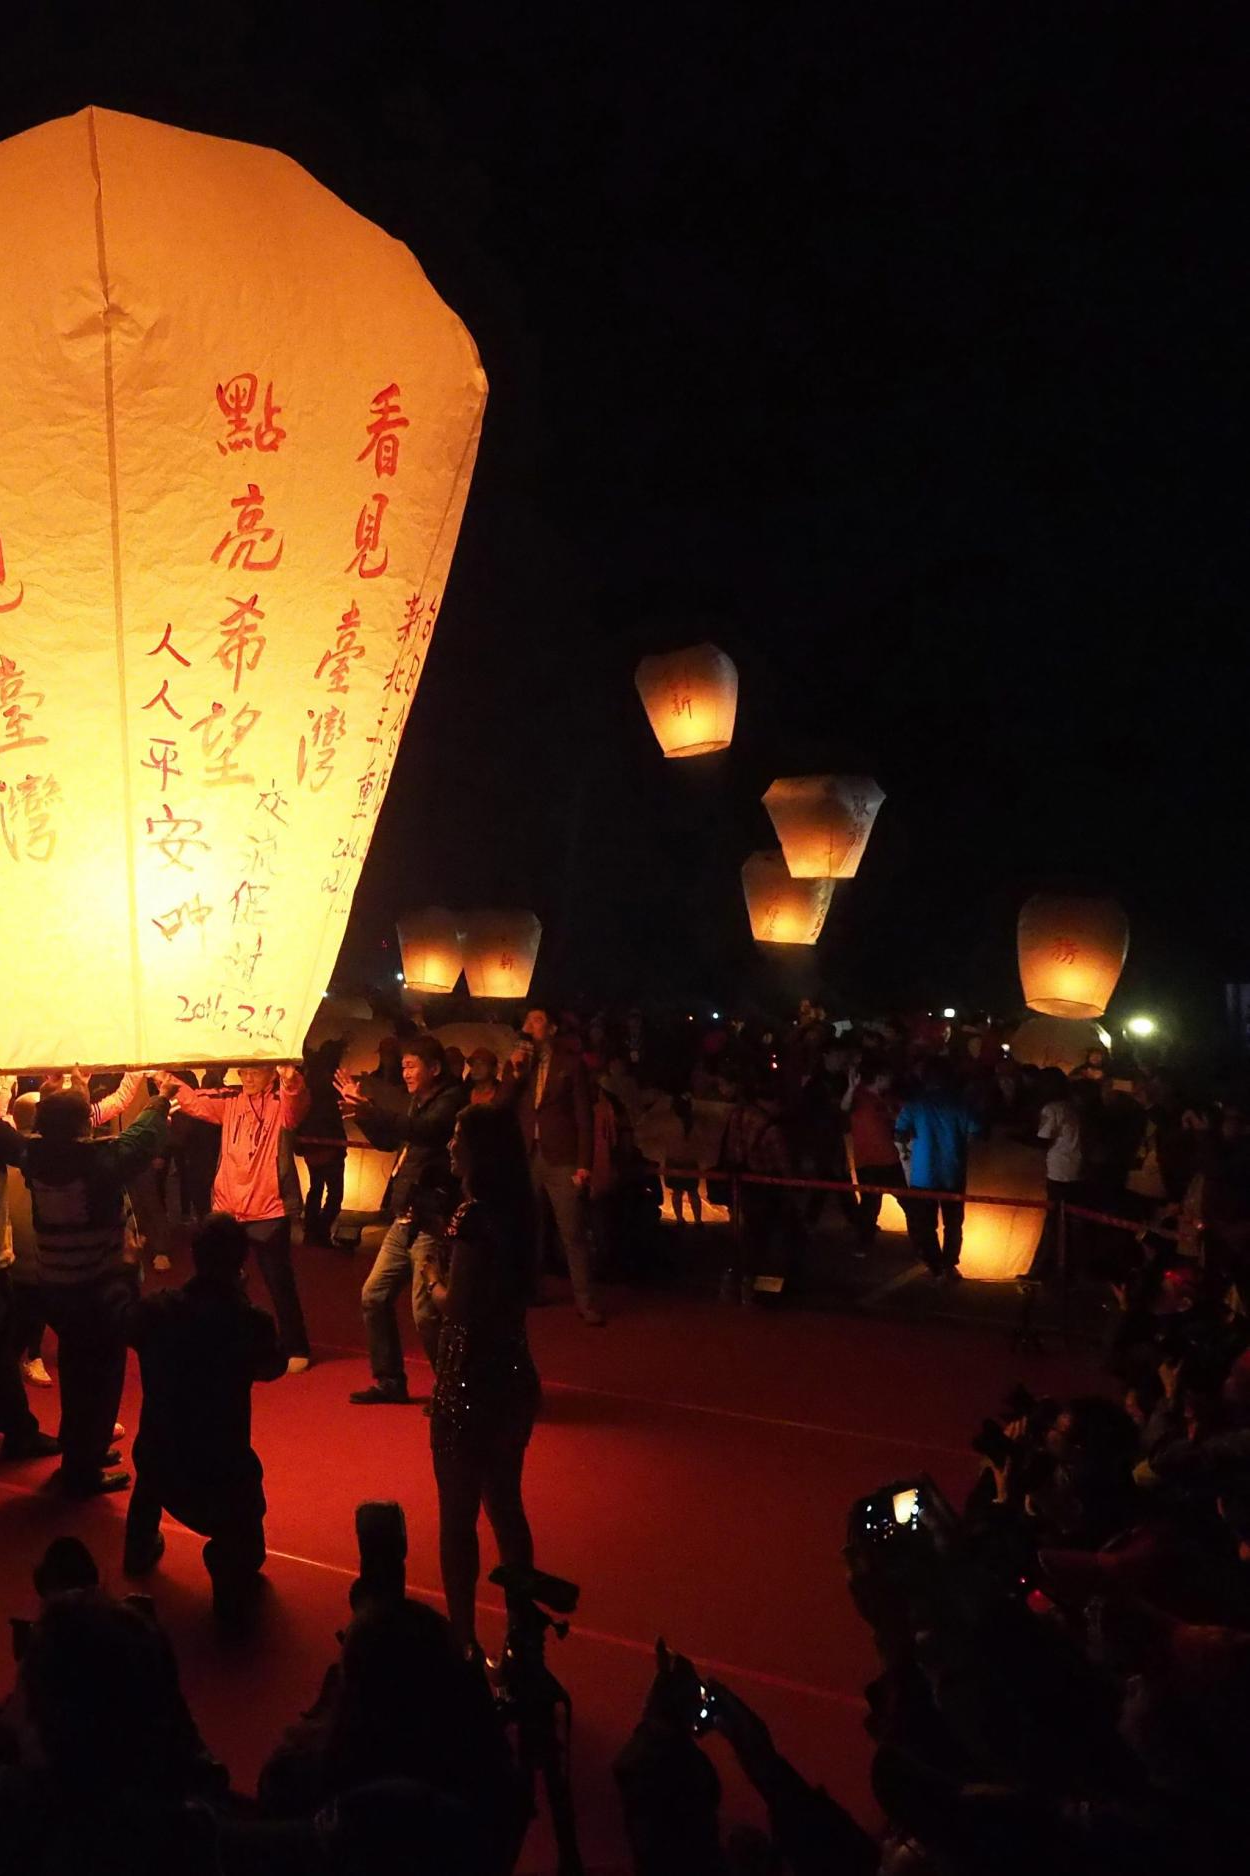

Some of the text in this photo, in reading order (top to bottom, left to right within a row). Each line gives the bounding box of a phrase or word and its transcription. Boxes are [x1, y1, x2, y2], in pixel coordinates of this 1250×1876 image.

[141, 622, 213, 872] 人人平安
[190, 372, 287, 788] 點亮希望
[296, 382, 410, 793] 看見臺灣
